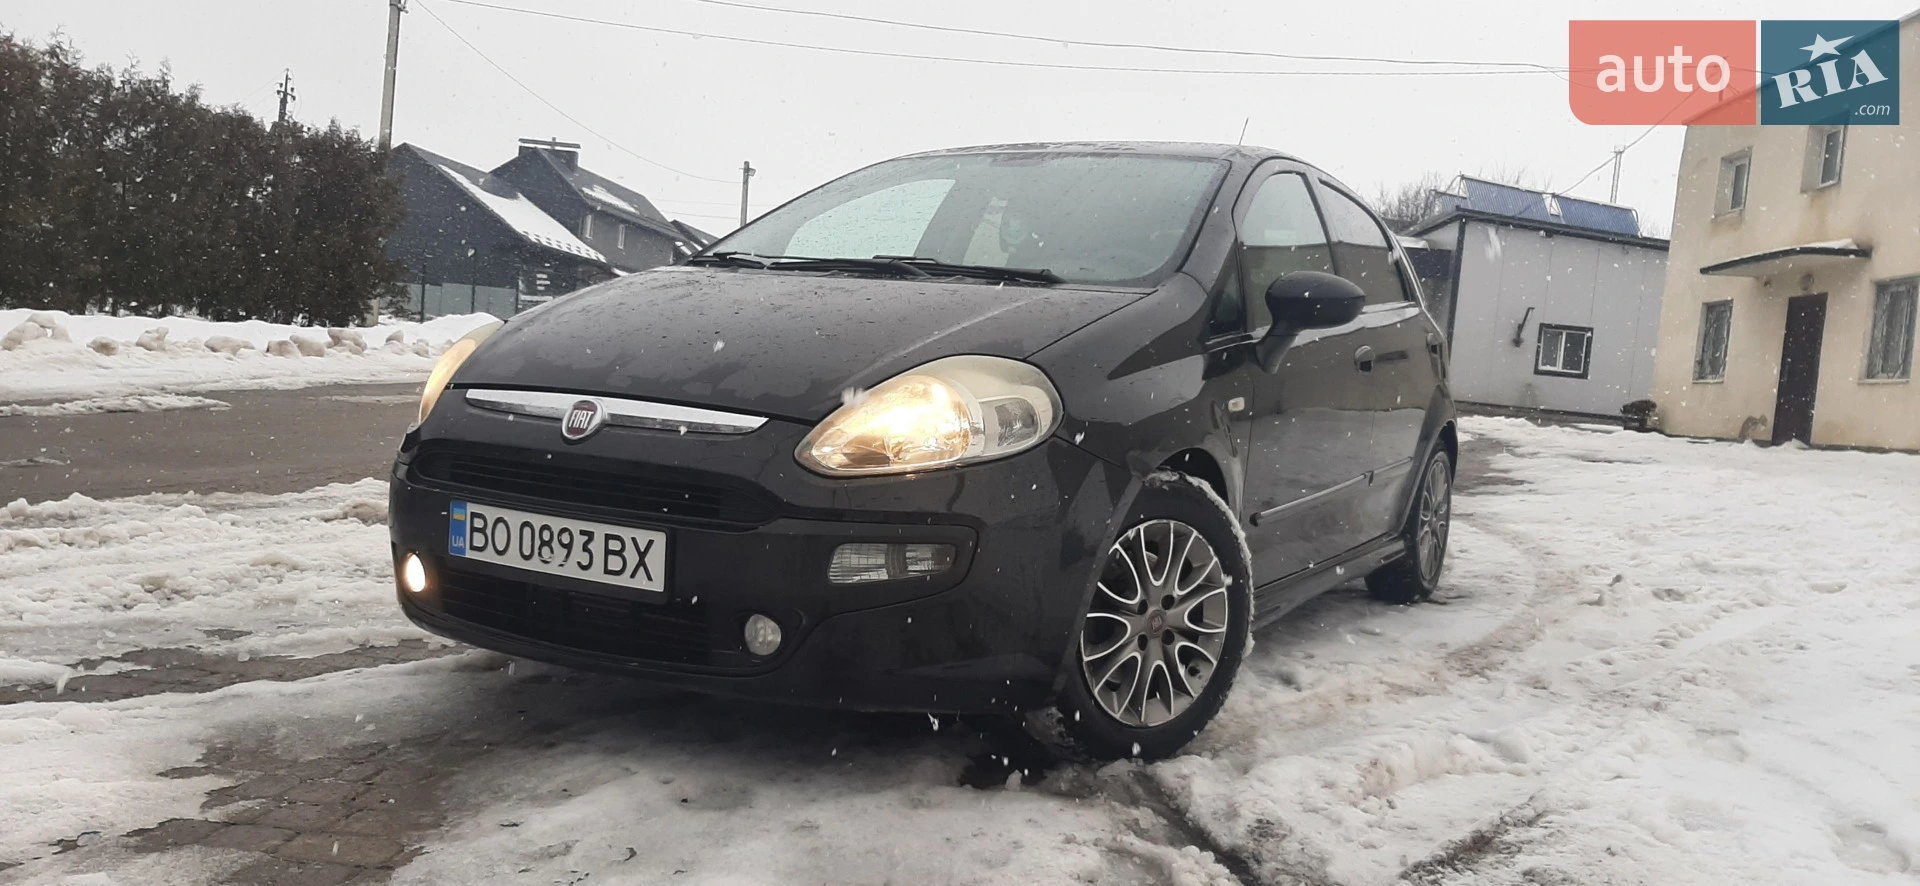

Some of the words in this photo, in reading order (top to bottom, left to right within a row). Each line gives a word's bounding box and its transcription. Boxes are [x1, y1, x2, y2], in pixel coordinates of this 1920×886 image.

[568, 410, 594, 429] FIAT
[452, 535, 464, 548] UA
[469, 511, 511, 556] BO
[519, 520, 595, 571] 0893
[603, 533, 655, 582] BX
